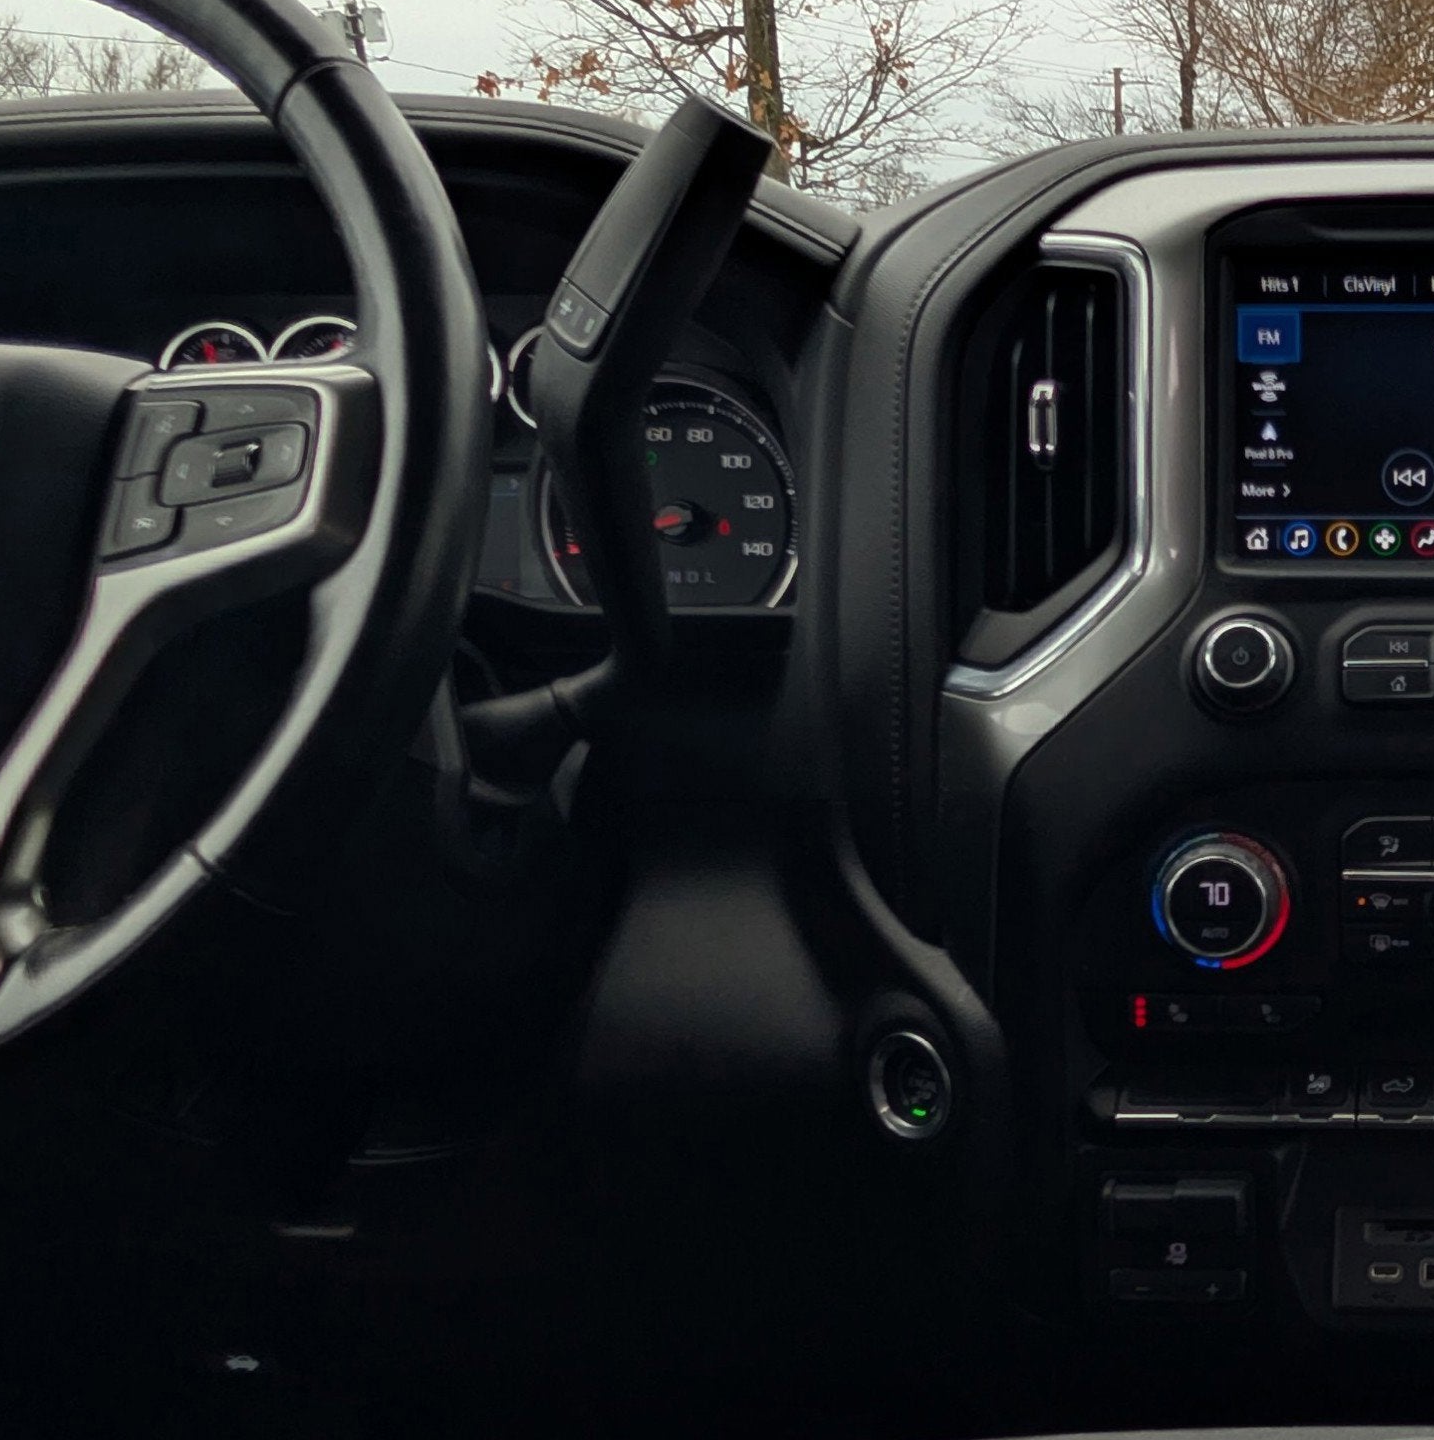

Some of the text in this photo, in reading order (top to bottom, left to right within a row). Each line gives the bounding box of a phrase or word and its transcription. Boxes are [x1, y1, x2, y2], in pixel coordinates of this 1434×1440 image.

[1260, 276, 1289, 293] Hits
[1257, 328, 1281, 345] FM
[645, 426, 672, 442] 60
[686, 426, 714, 443] 80
[1276, 447, 1294, 460] Pro
[720, 455, 752, 469] 100
[1241, 482, 1276, 498] More
[742, 494, 774, 510] 120
[741, 541, 774, 557] 140
[1198, 882, 1230, 907] 70
